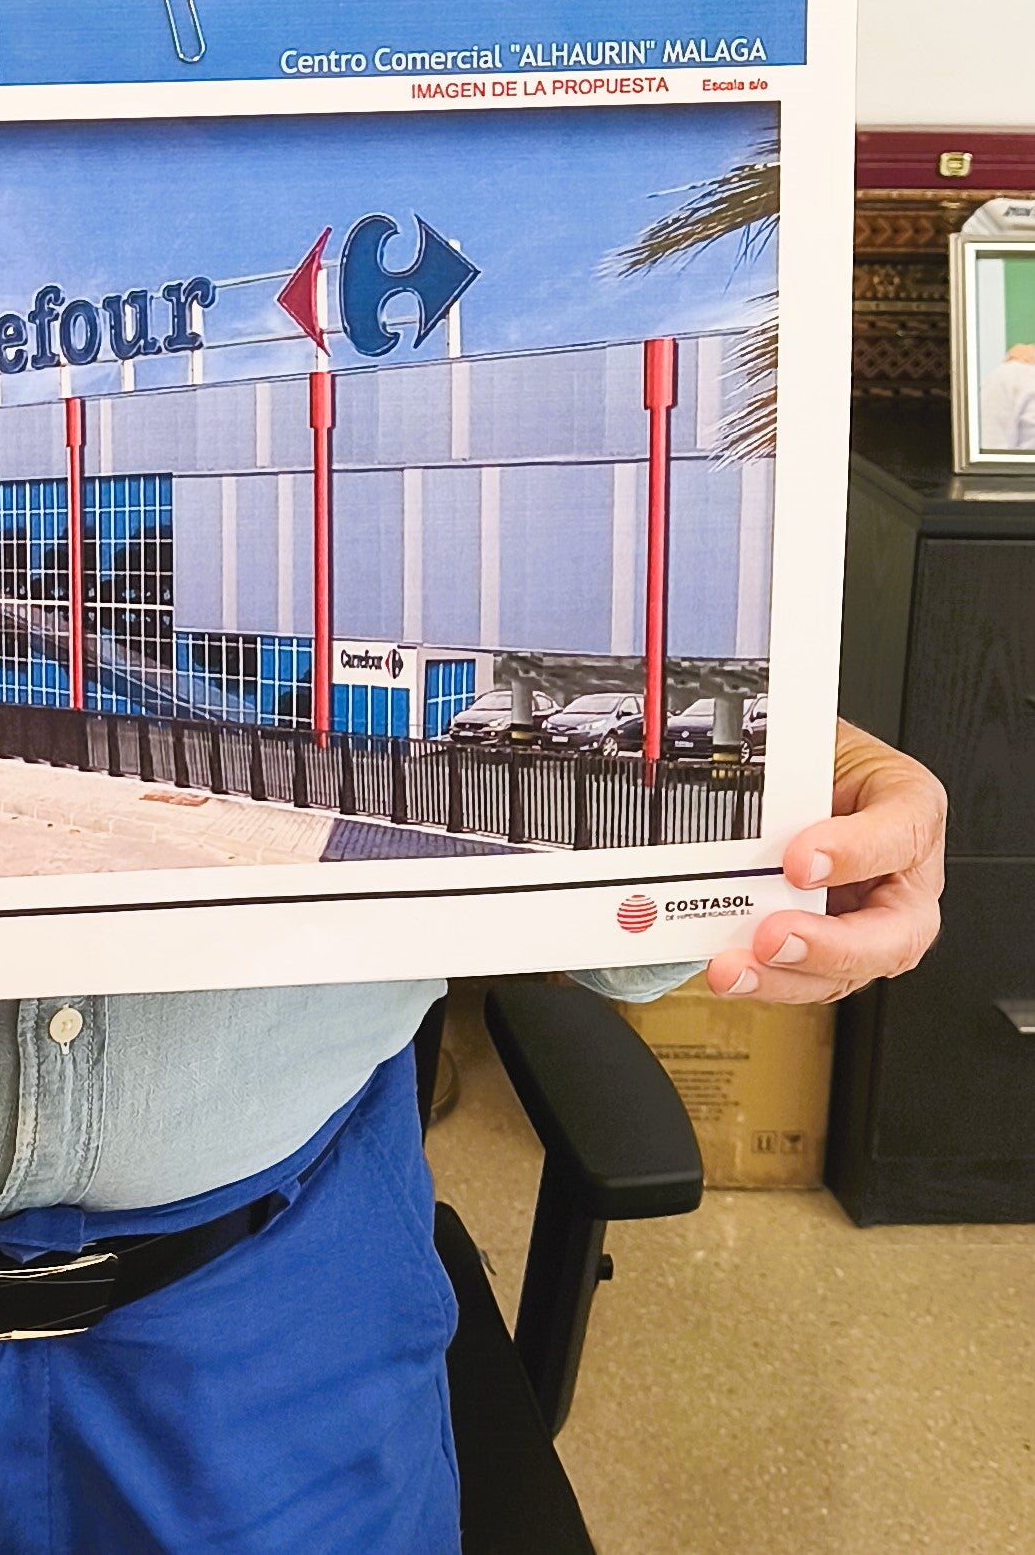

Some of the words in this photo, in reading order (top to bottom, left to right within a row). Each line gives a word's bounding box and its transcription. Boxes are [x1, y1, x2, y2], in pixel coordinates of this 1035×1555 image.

[280, 50, 366, 74] Centro
[374, 44, 502, 71] Comercial
[510, 39, 656, 67] "ALHAURIN"
[662, 37, 767, 63] MALAGA
[411, 82, 486, 99] IMAGEN
[491, 80, 518, 96] DE
[523, 80, 547, 96] LA
[552, 77, 670, 96] PROPUESTA
[702, 78, 745, 91] Escala
[665, 895, 754, 912] COSTASOL
